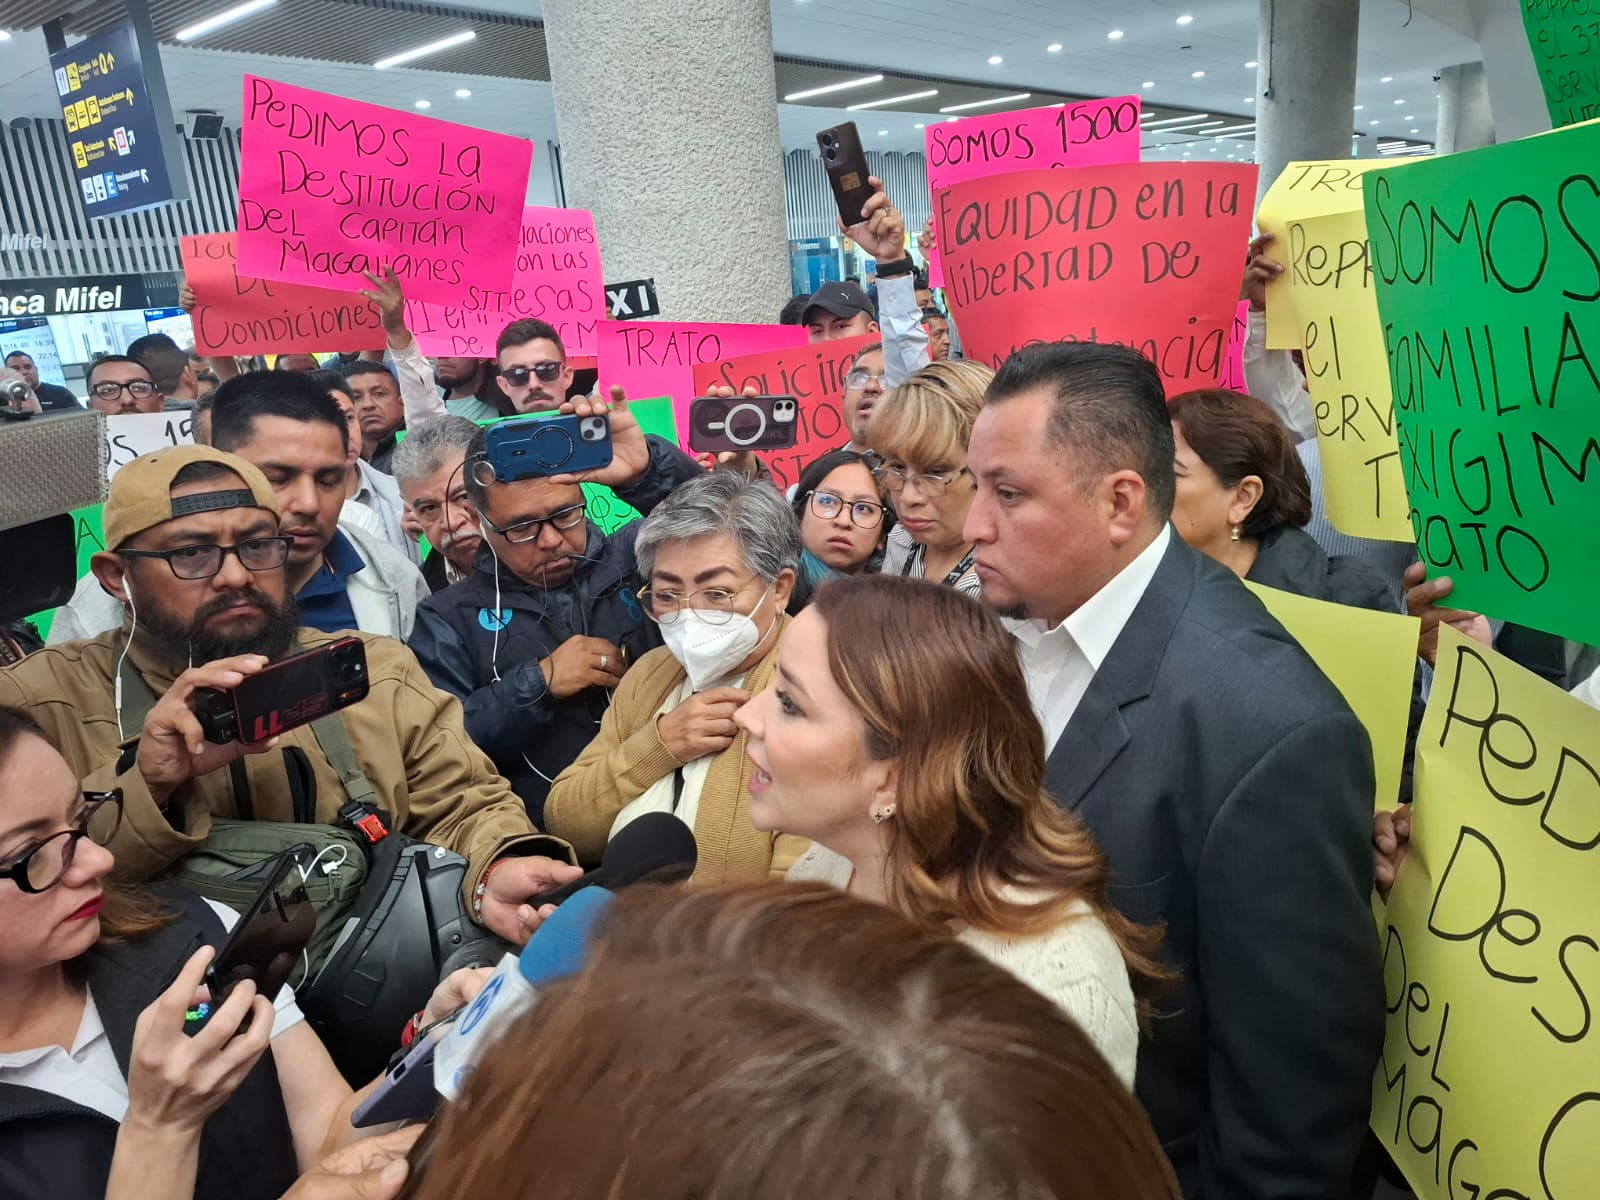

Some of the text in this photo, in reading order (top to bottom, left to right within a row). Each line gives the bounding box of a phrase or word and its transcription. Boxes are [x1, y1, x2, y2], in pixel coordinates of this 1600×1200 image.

[251, 79, 481, 183] PeDIMOS La
[930, 102, 1138, 167] SOMOS 1500
[240, 199, 305, 237] DeL
[517, 223, 595, 248] laciones
[939, 179, 1239, 256] EQUIDaD en la
[1, 232, 47, 250] Mifel
[1375, 174, 1600, 301] SOMOS
[514, 253, 543, 272] on
[950, 240, 1199, 308] libeRTaD De
[55, 285, 122, 313] Mifel
[605, 285, 650, 318] XI
[452, 335, 483, 355] De
[616, 327, 721, 366] TRATO
[1428, 826, 1599, 1043] DeS
